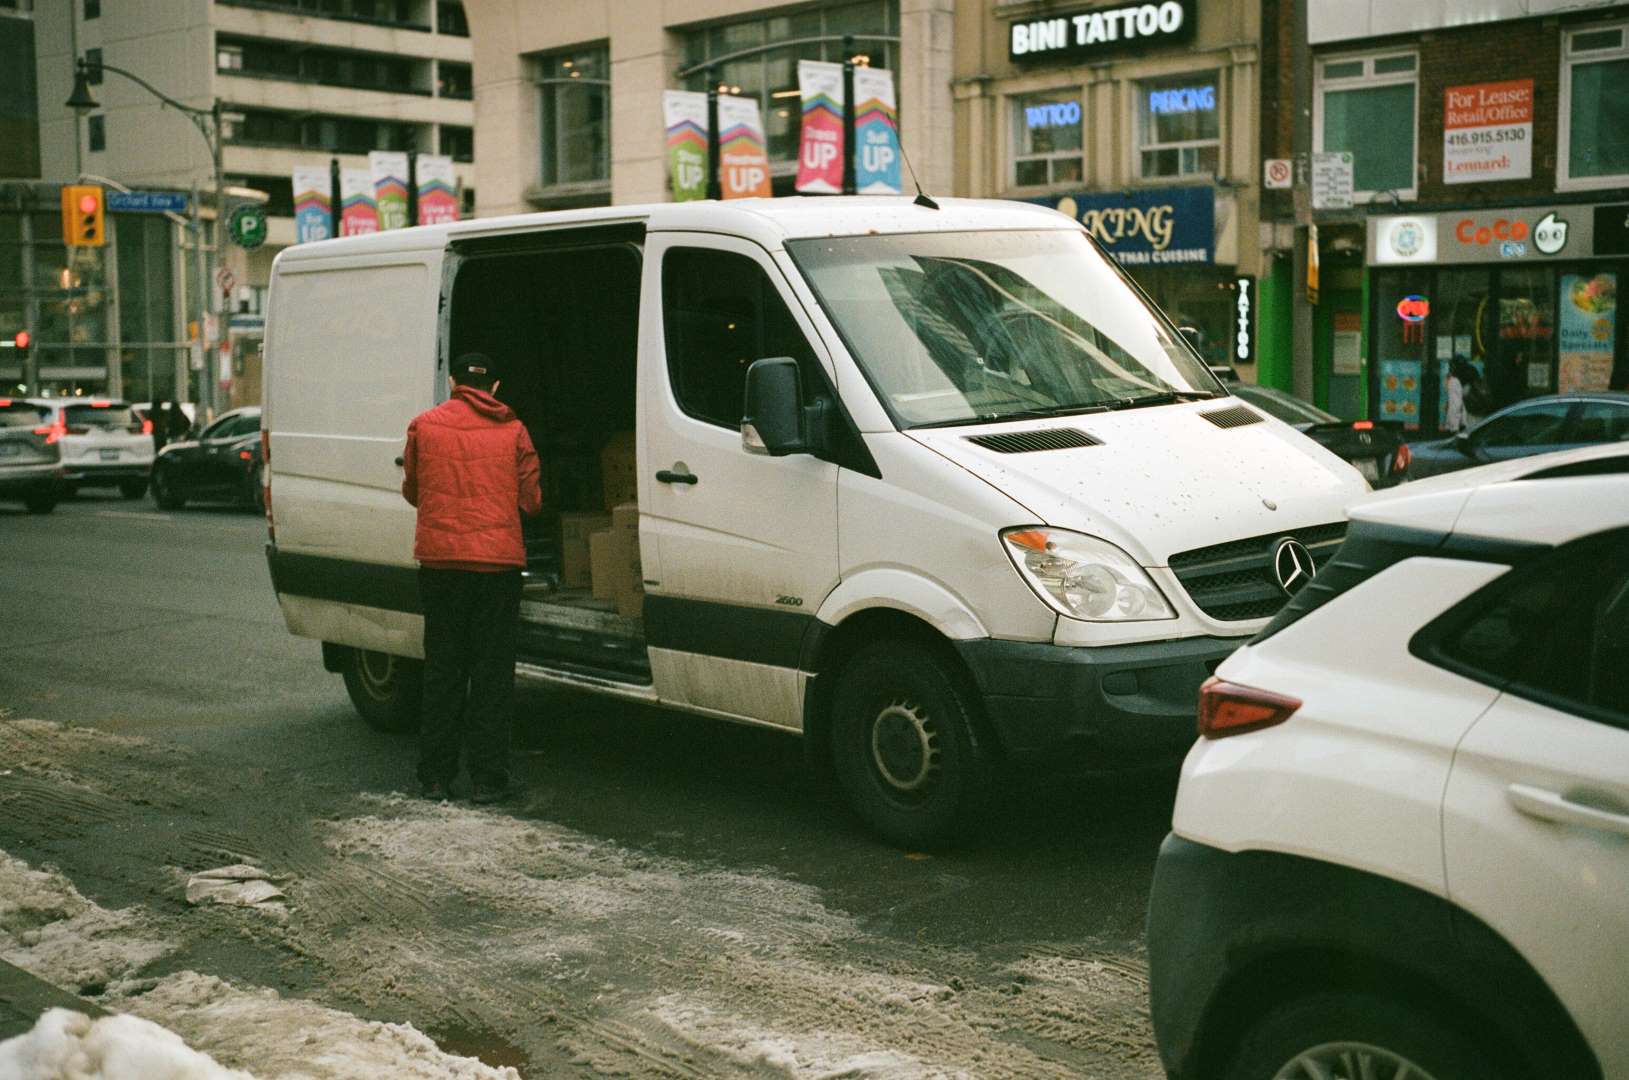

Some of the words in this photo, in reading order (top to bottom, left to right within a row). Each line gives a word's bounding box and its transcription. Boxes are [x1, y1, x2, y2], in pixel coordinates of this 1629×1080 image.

[1011, 19, 1068, 55] BINI
[1072, 1, 1184, 46] TATTOO
[1150, 86, 1216, 113] PIERCING
[1448, 92, 1475, 109] For
[1479, 89, 1529, 107] Lease:
[1025, 101, 1081, 127] TATTOO
[1447, 104, 1529, 125] Retail/Office
[1447, 127, 1526, 145] 416.915.5130
[803, 141, 837, 170] UP
[863, 145, 895, 173] UP
[677, 163, 704, 190] UP
[729, 167, 765, 193] UP
[1082, 205, 1174, 250] KING
[1151, 248, 1208, 263] CUISINE
[1237, 278, 1251, 359] TATTOO
